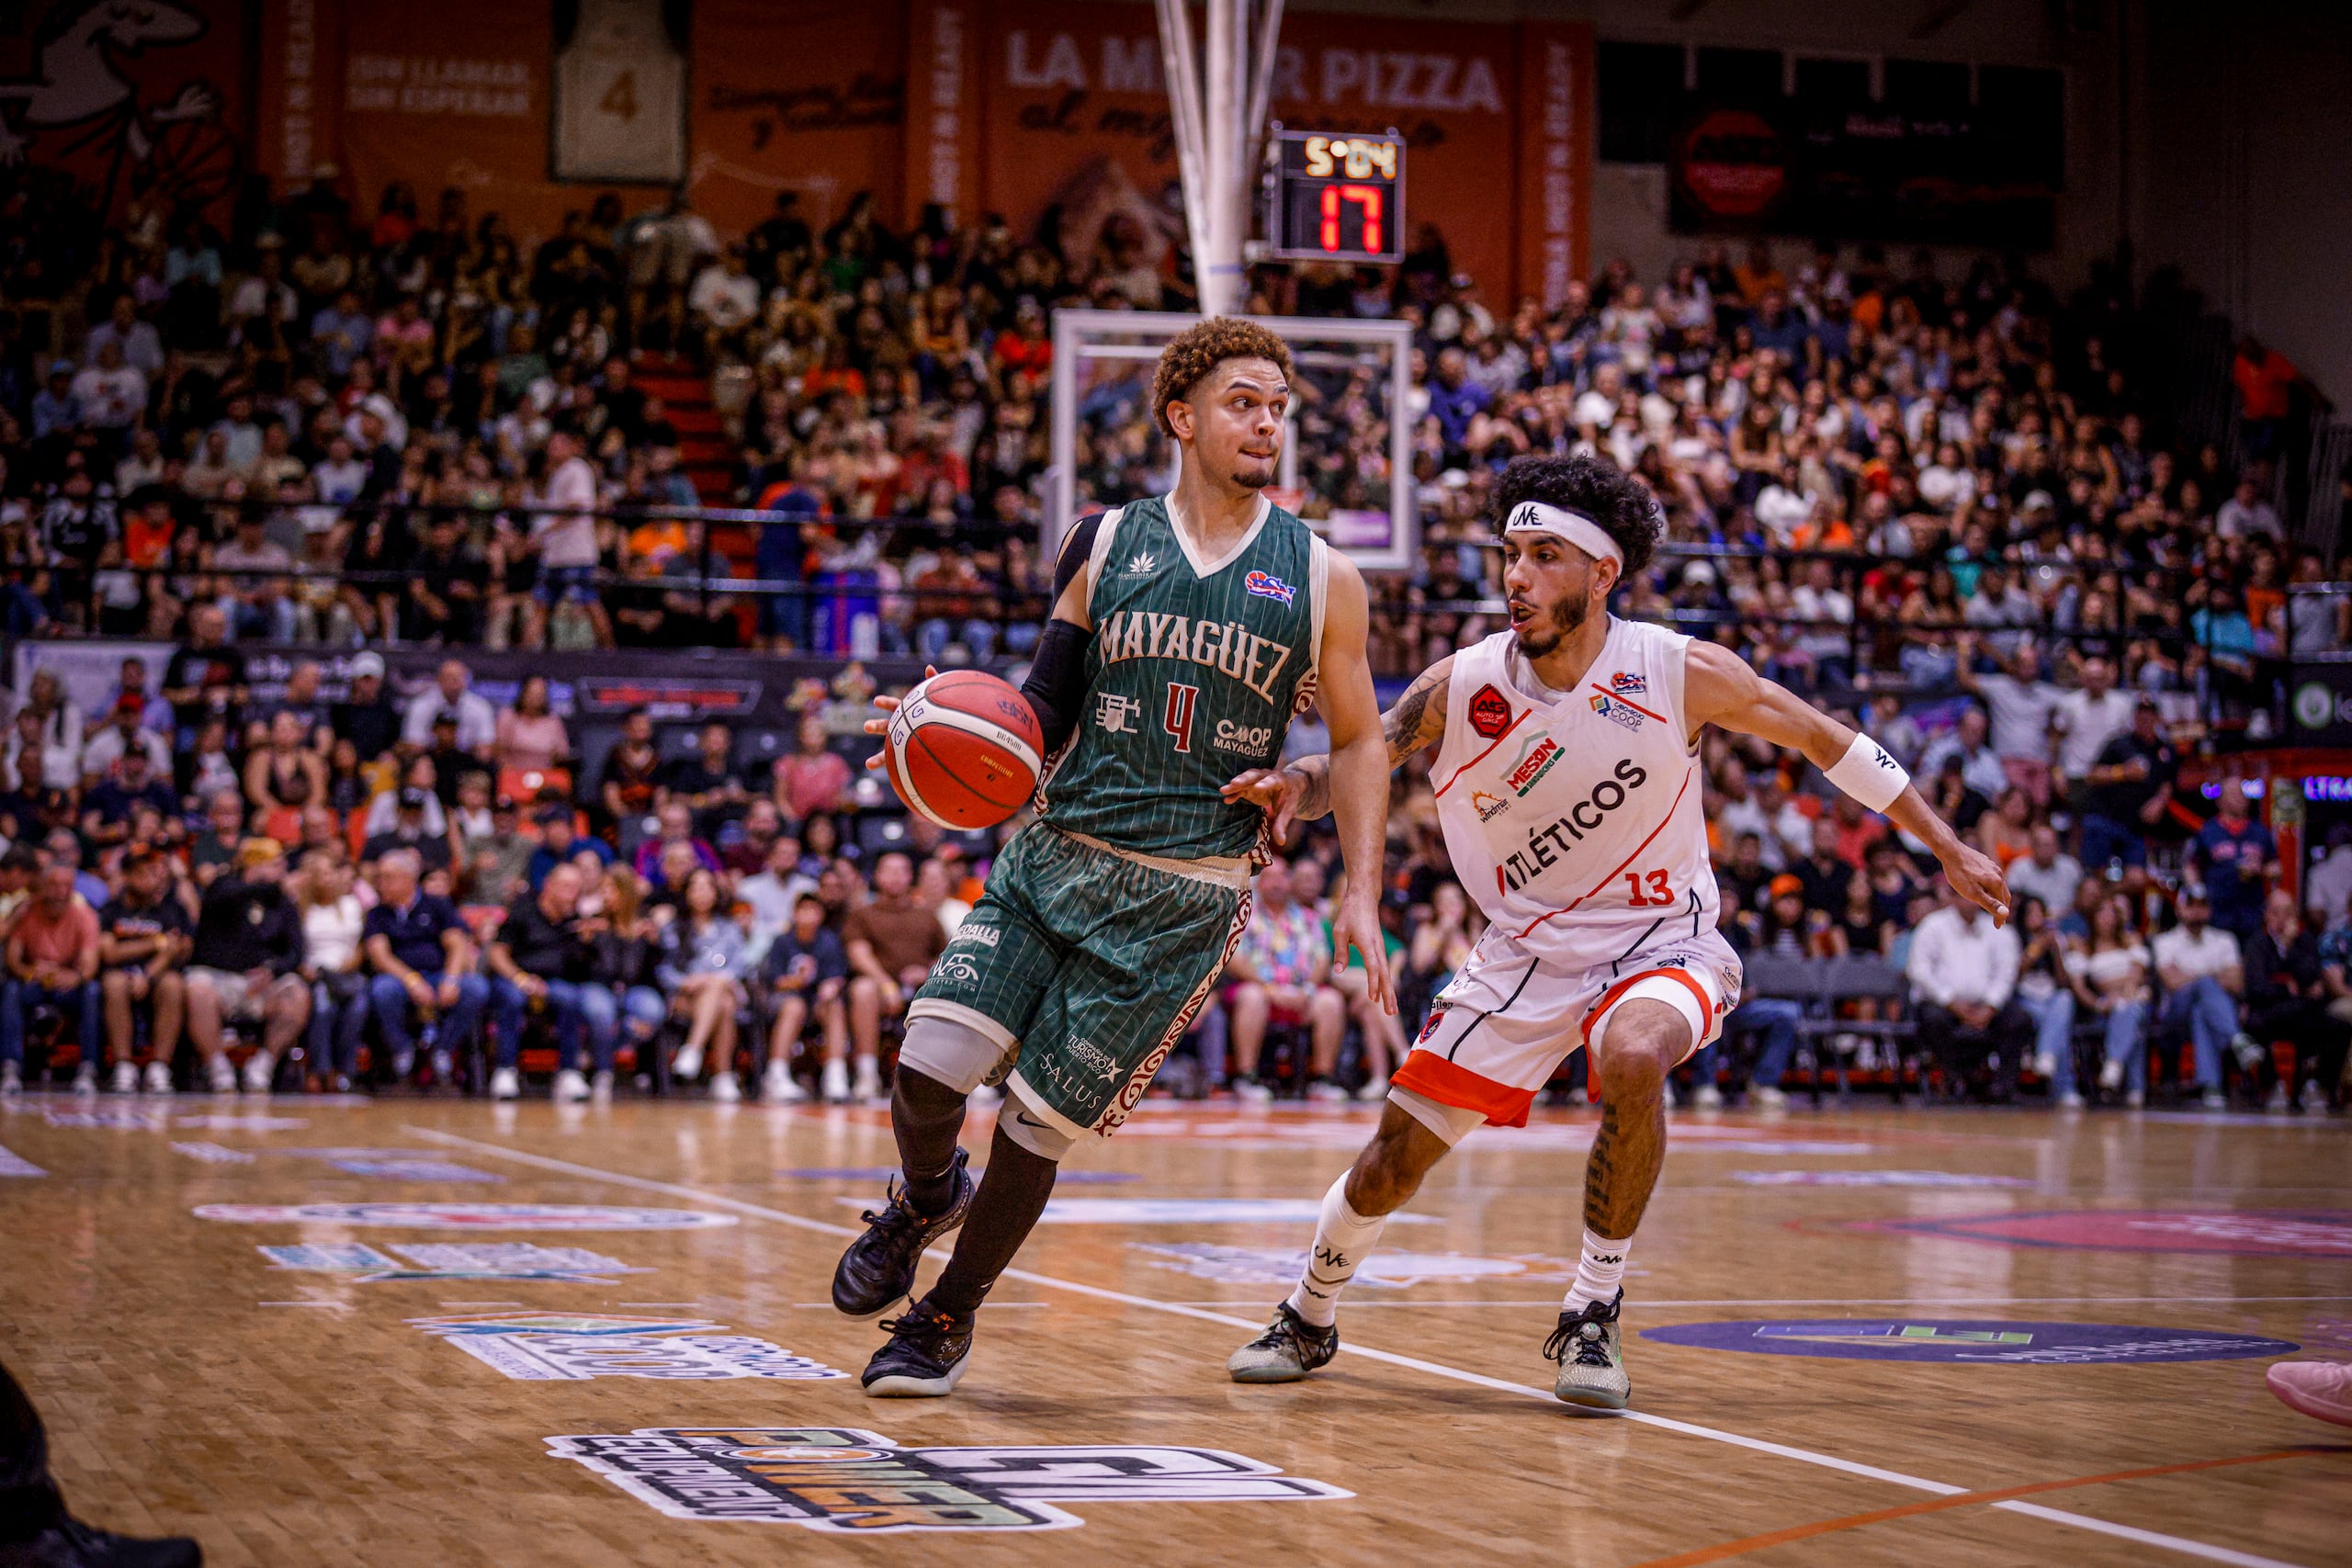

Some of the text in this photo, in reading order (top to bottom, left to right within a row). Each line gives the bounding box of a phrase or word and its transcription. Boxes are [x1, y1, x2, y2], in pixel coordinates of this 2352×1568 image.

[1007, 30, 1088, 88] LA
[1322, 46, 1505, 114] PIZZA
[599, 70, 640, 123] 4
[1320, 185, 1382, 255] 17
[1099, 611, 1291, 706] MAYAGÜEZ
[1163, 682, 1200, 753] 4
[1611, 708, 1643, 728] COOP
[1496, 759, 1647, 897] ATLÉTICOS
[1625, 868, 1676, 907] 13
[1066, 1044, 1102, 1075] PUERTO RICO
[1068, 1034, 1107, 1068] TURISMO
[1040, 1053, 1102, 1109] SALUS
[586, 1438, 811, 1518] EQUIPMENT
